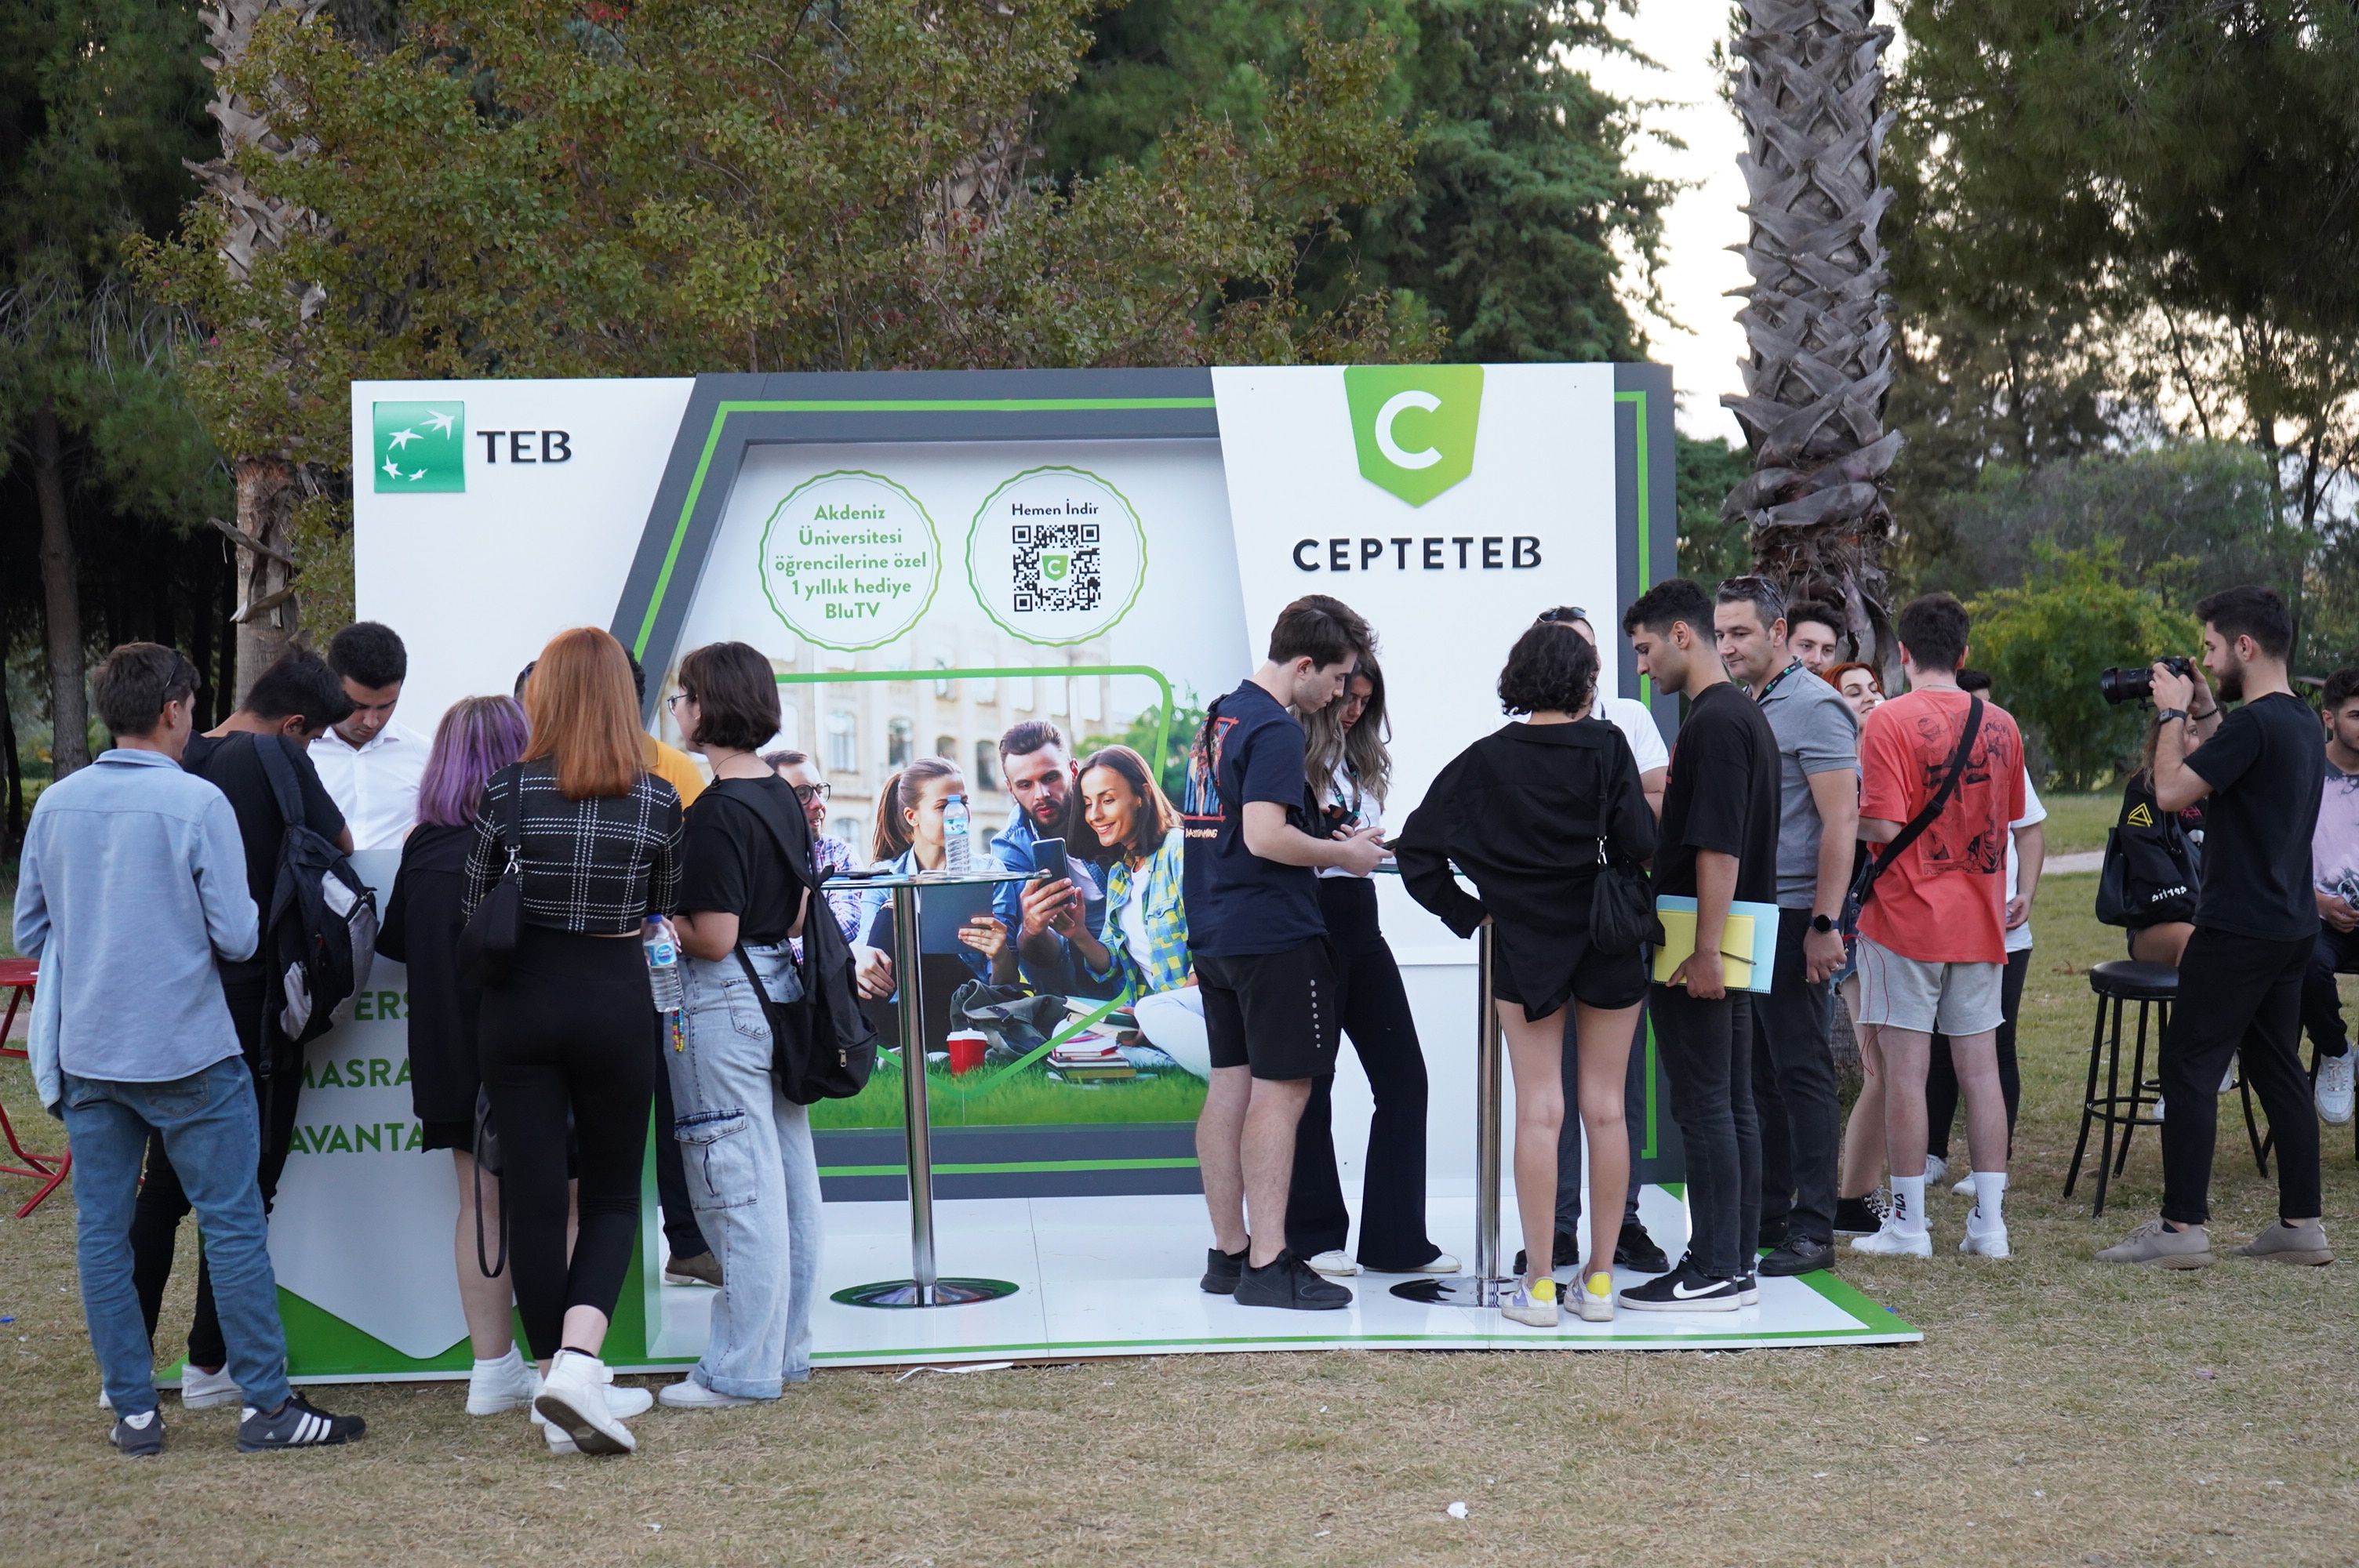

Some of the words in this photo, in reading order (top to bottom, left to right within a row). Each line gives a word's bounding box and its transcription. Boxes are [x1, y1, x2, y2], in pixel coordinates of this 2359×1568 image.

[1375, 390, 1443, 470] C
[476, 430, 572, 463] TEB
[814, 504, 885, 521] Akdeniz
[1012, 503, 1061, 516] Hemen
[1066, 498, 1100, 515] İndir
[798, 524, 903, 546] Üniversitesi
[775, 554, 889, 577] öğrencilerine
[894, 551, 927, 568] özel
[1292, 535, 1543, 572] CEPTETEB
[791, 580, 799, 596] 1
[805, 579, 849, 601] yıllık
[854, 578, 912, 598] hediye
[825, 602, 880, 619] BluTV
[354, 991, 409, 1021] ER
[1894, 1192, 1906, 1221] FILA
